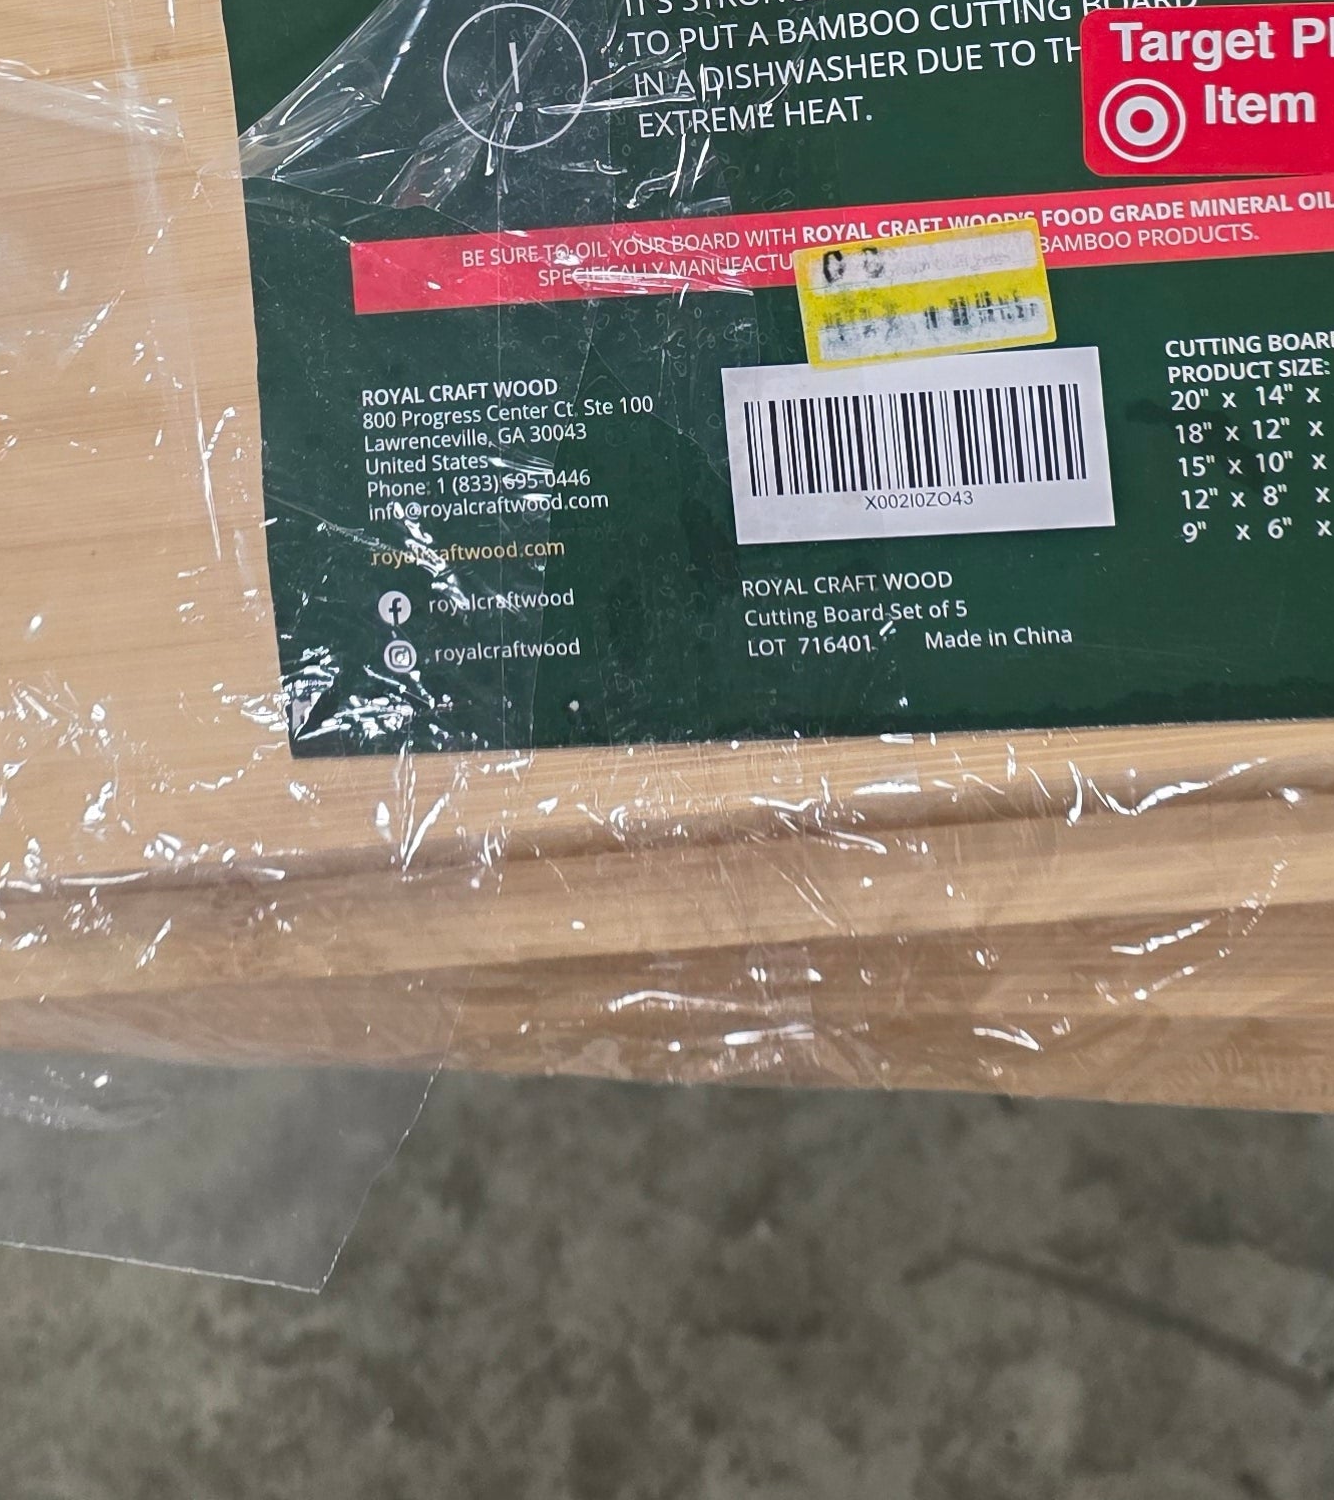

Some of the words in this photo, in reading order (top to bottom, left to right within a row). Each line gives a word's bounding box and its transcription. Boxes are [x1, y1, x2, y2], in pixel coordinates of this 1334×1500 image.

[627, 29, 669, 57] TO
[680, 24, 738, 52] PUT
[748, 21, 769, 47] A
[777, 7, 919, 44] BAMBOO
[1110, 21, 1274, 71] Target
[634, 72, 663, 98] IN
[674, 70, 695, 94] A
[704, 51, 907, 92] DISHWASHER
[918, 44, 983, 75] DUE
[991, 40, 1035, 68] TO
[639, 103, 775, 138] EXTREME
[785, 96, 872, 125] HEAT.
[1205, 84, 1316, 124] Item
[462, 250, 484, 268] BE
[490, 246, 538, 266] SURE
[580, 241, 607, 258] OIL
[612, 236, 665, 257] YOUR
[673, 232, 739, 253] BOARD
[745, 227, 795, 248] WITH
[802, 221, 872, 243] ROYAL
[877, 217, 942, 238] CRAFT
[1042, 208, 1103, 227] FOOD
[1110, 201, 1184, 223] GRADE
[1190, 194, 1293, 219] MINERAL
[1138, 223, 1259, 247] PRODUCTS.
[1165, 336, 1261, 358] CUTTING
[1168, 361, 1274, 384] PRODUCT
[1279, 357, 1330, 378] SIZE:
[362, 387, 424, 407] ROYAL
[429, 382, 488, 402] CRAFT
[494, 378, 558, 398] WOOD
[1171, 389, 1209, 411] 20"
[1223, 392, 1236, 408] x
[1255, 384, 1293, 406] 14"
[1306, 387, 1321, 403] x
[363, 412, 396, 429] 800
[402, 409, 481, 429] Progress
[486, 402, 548, 422] Center
[584, 399, 613, 416] Ste
[620, 396, 654, 414] 100
[364, 429, 493, 452] Lawrenceville,
[498, 427, 525, 444] GA
[529, 423, 587, 442] 30043
[1175, 422, 1212, 444] 18"
[1225, 426, 1239, 441] x
[1252, 417, 1290, 440] 12"
[1308, 420, 1324, 437] x
[365, 456, 427, 475] United
[431, 453, 488, 472] States
[1178, 455, 1215, 477] 15"
[1228, 459, 1243, 475] x
[1256, 451, 1293, 473] 10"
[1312, 454, 1327, 470] x
[367, 478, 431, 498] Phone:
[437, 477, 445, 494] 1
[452, 475, 499, 496] (833)
[1181, 488, 1218, 510] 12"
[1230, 491, 1246, 508] x
[1263, 484, 1287, 506] 8"
[1315, 486, 1331, 503] x
[1182, 521, 1207, 543] 9"
[1268, 517, 1292, 539] 6"
[742, 578, 808, 598] ROYAL
[814, 574, 877, 595] CRAFT
[882, 571, 953, 591] WOOD
[745, 607, 817, 628] Cutting
[824, 603, 883, 623] Board
[890, 602, 923, 620] Set
[929, 600, 949, 618] of
[955, 600, 967, 617] 5
[435, 637, 581, 666] royalcraftwood
[748, 639, 786, 657] LOT
[798, 634, 872, 656] 716401
[925, 630, 982, 650] Made
[989, 628, 1007, 647] in
[1013, 626, 1072, 646] China
